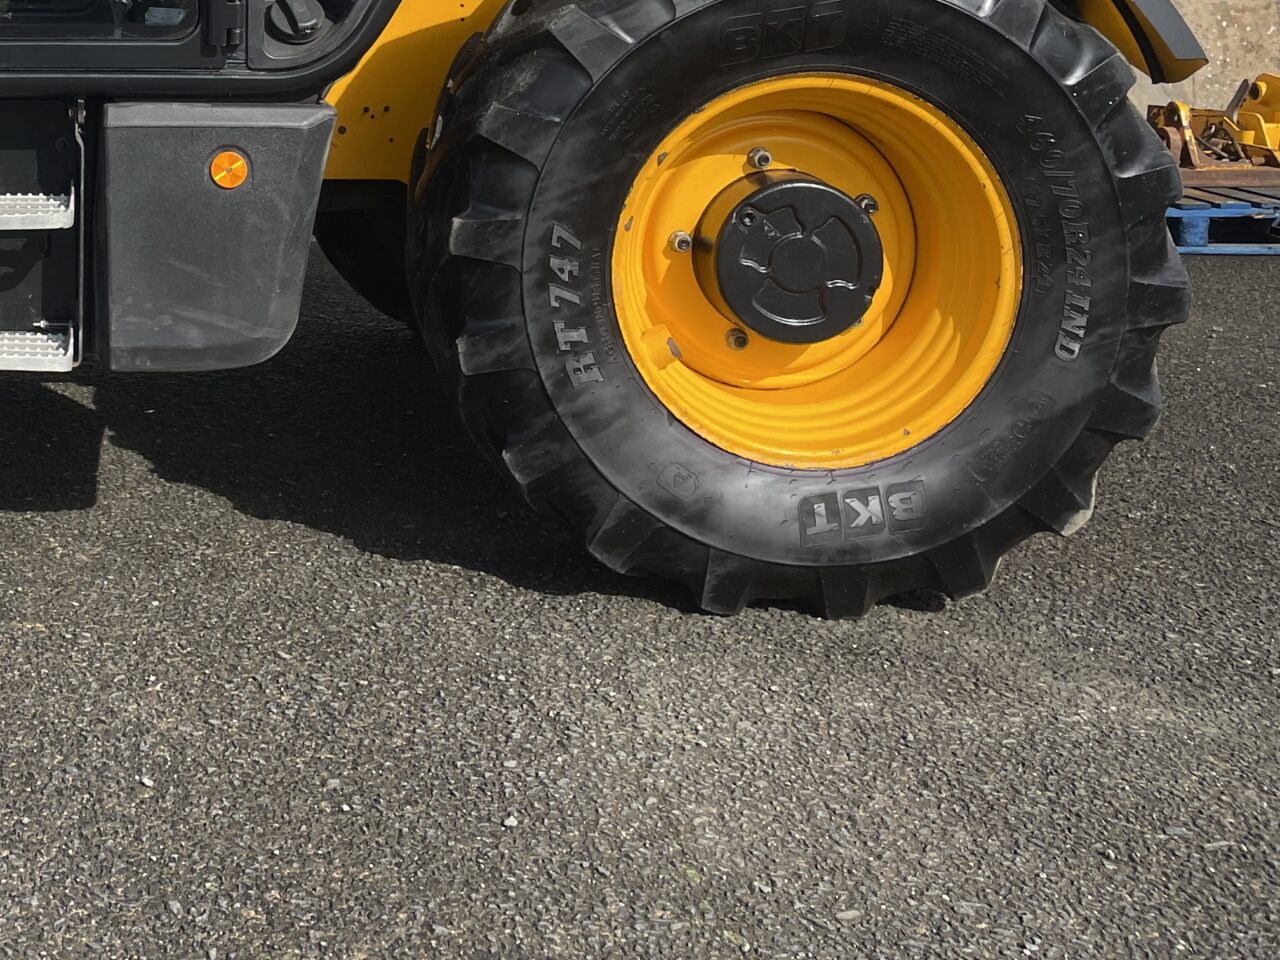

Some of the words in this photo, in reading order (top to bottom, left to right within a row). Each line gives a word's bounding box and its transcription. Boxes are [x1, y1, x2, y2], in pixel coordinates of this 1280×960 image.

[724, 4, 848, 60] BKT
[547, 220, 582, 308] 747
[557, 319, 604, 388] RT
[802, 489, 920, 538] BKT
